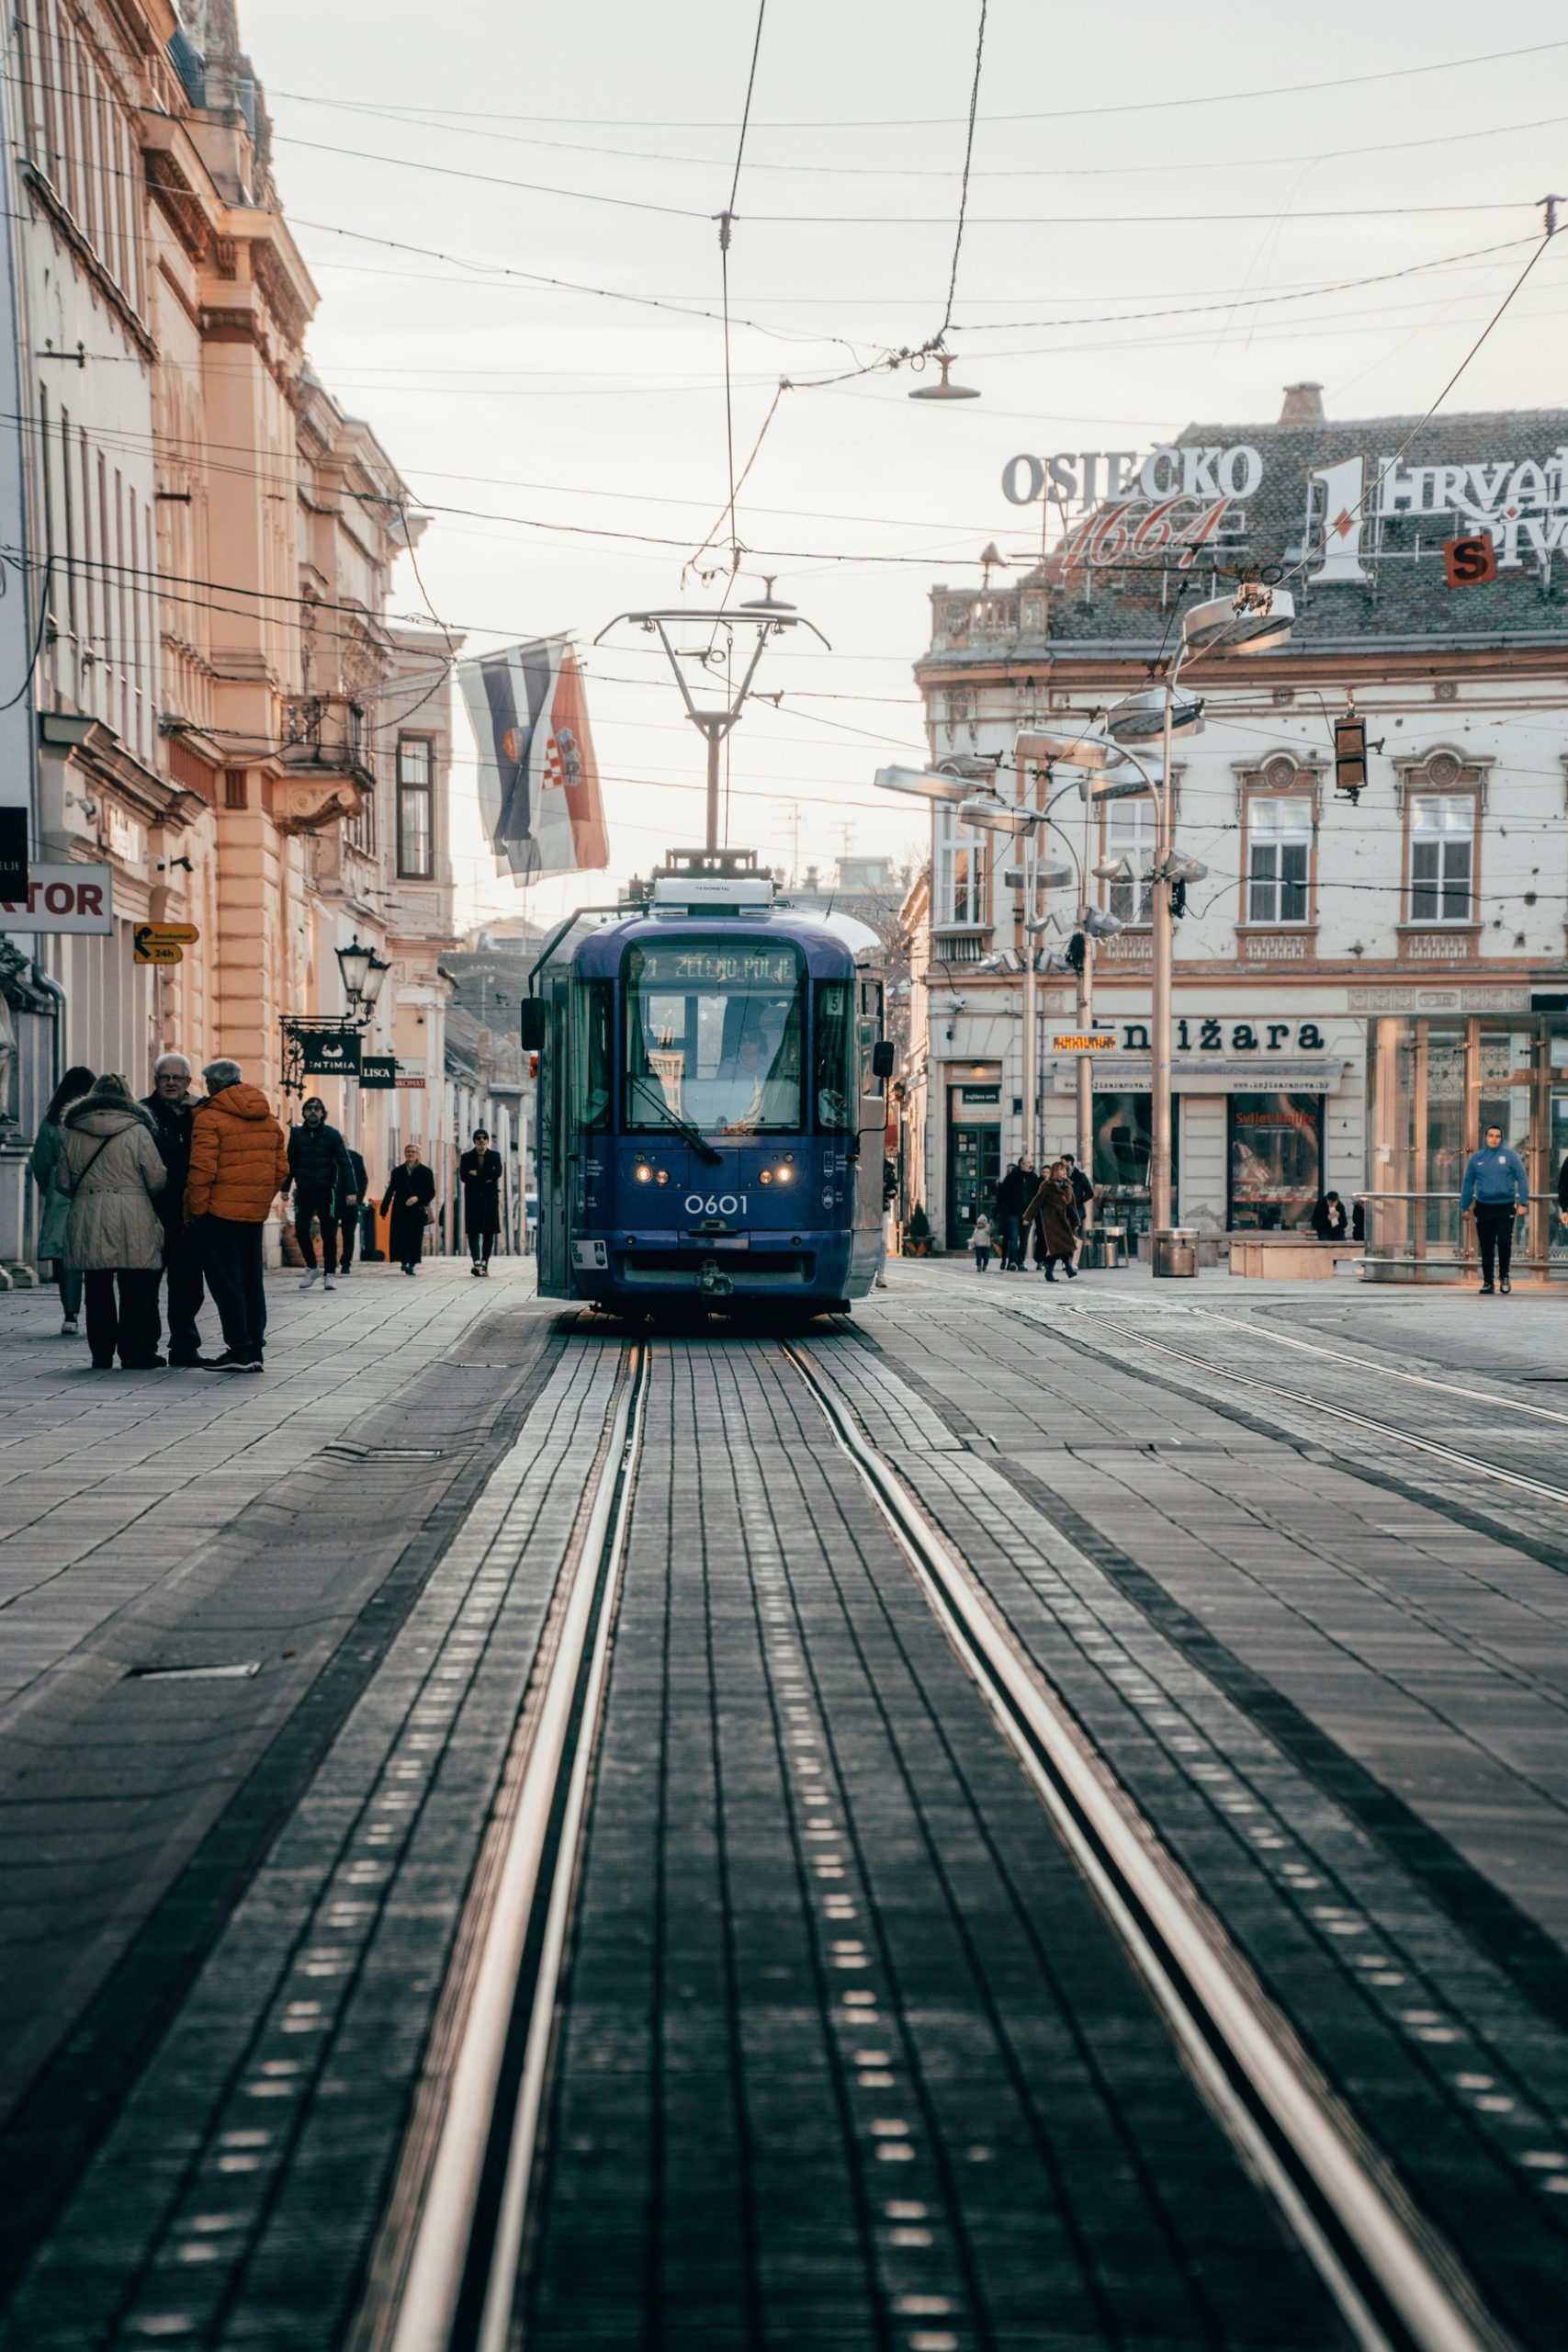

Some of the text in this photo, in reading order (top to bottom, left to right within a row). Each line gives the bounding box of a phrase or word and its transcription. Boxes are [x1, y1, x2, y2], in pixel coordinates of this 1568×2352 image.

[1002, 443, 1263, 514] OSJEČKO
[1061, 495, 1232, 568] 1664
[1453, 541, 1488, 580] S
[154, 949, 175, 957] 24h
[675, 956, 736, 978] ZELENO
[744, 956, 794, 978] POLJE
[831, 998, 839, 1012] 5
[364, 1068, 390, 1078] LISCA
[684, 1195, 748, 1214] 0601
